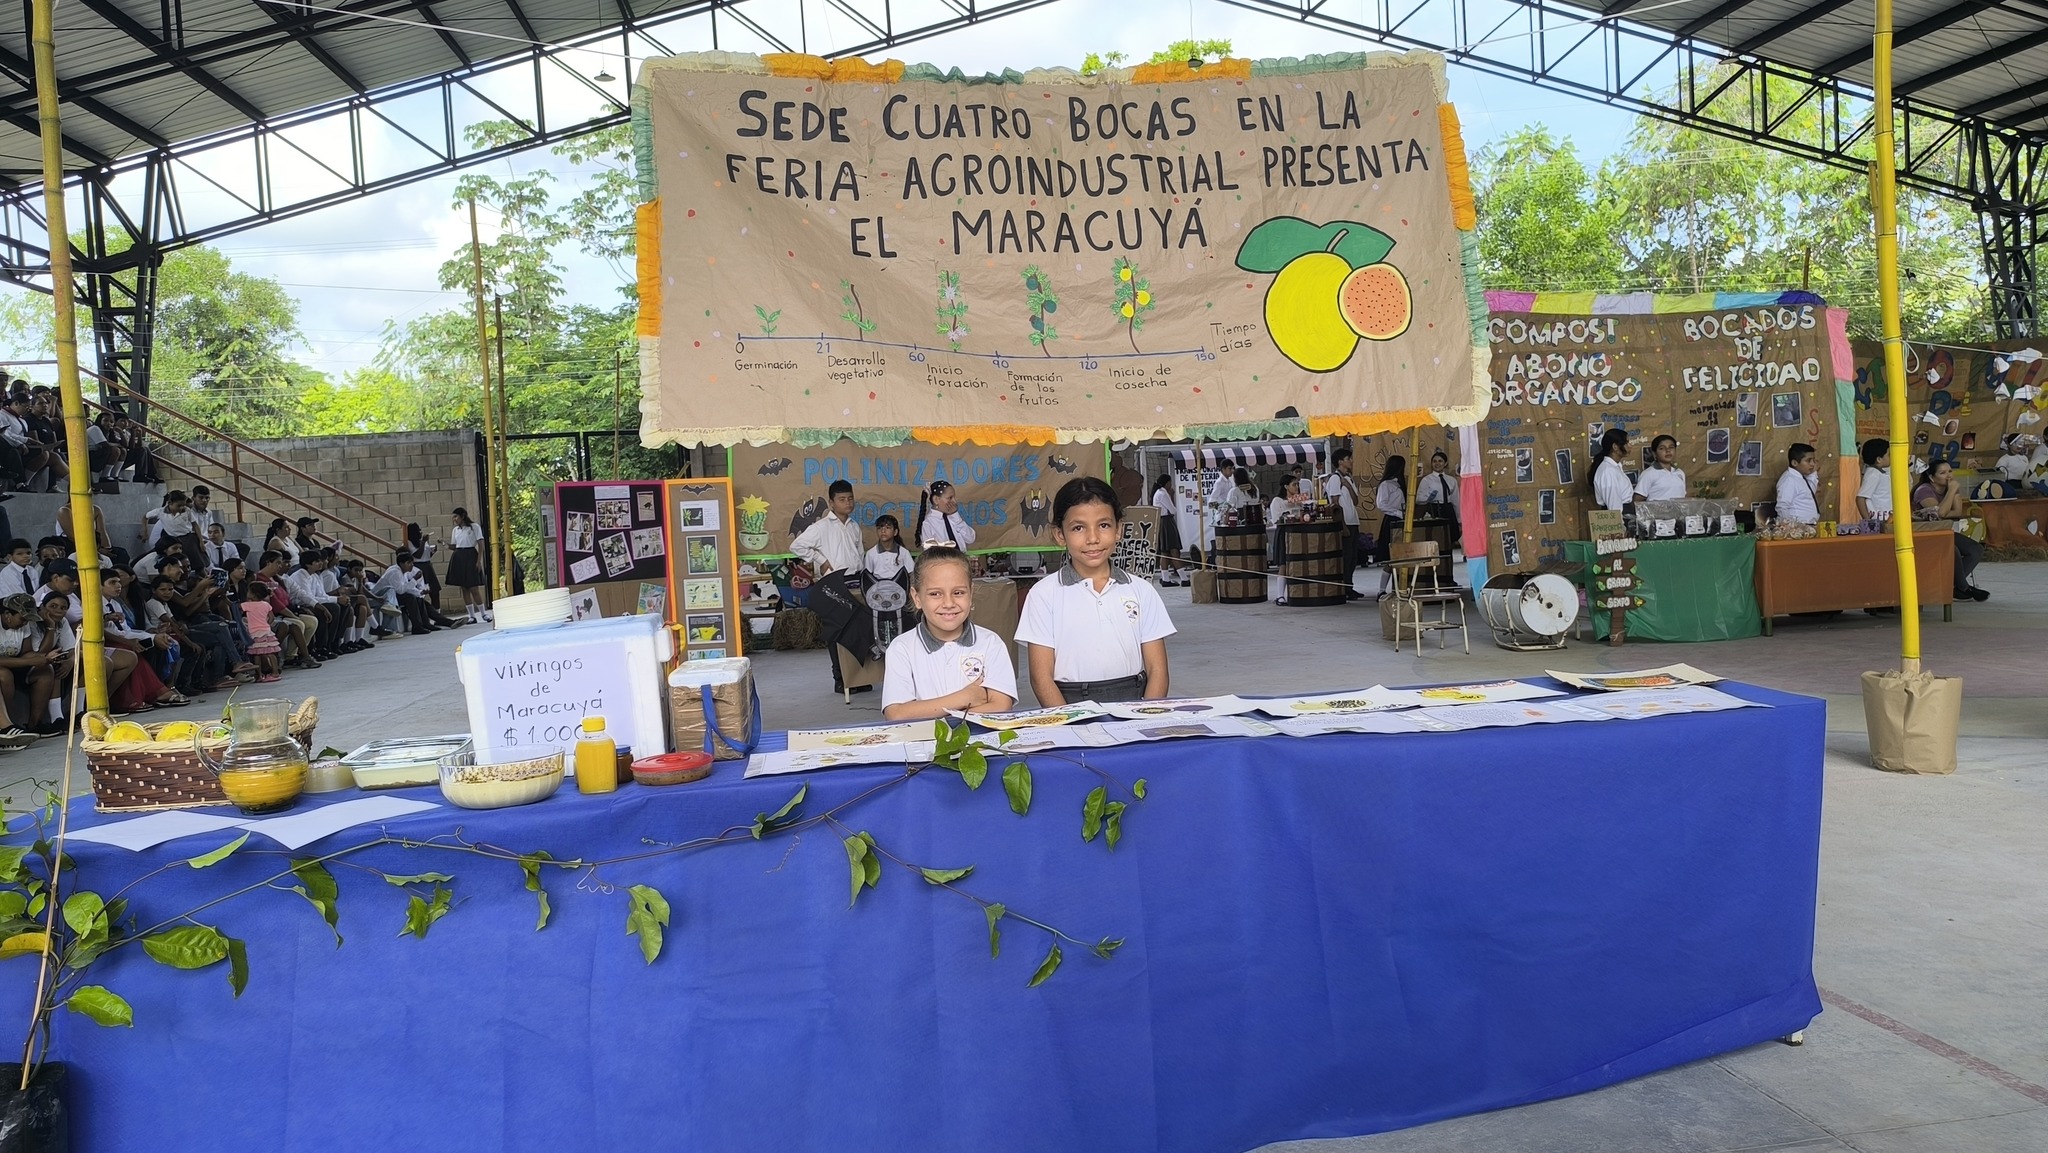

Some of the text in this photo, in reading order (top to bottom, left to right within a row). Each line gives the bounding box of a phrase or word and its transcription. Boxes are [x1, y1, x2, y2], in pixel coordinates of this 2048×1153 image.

[737, 89, 1361, 143] SEDE CUATRO BOCAS EN LA
[726, 138, 1429, 202] FERIA AGROINDUSTRIAL PRESENTA
[851, 198, 1207, 258] EL MARACUYÁ
[1210, 322, 1257, 339] Tiempo
[1683, 305, 1816, 342] BOCADOS
[735, 342, 745, 354] 0
[816, 342, 830, 354] 21
[1219, 338, 1252, 353] días
[1734, 337, 1763, 362] DE
[827, 351, 886, 368] Desarrollo
[908, 351, 926, 363] 60
[1195, 351, 1216, 362] 150
[734, 359, 798, 371] Germinación
[926, 363, 963, 376] Inicio
[992, 359, 1009, 370] 90
[1079, 360, 1098, 371] 120
[1108, 363, 1172, 378] Inicio de
[1505, 352, 1612, 381] ABONO
[827, 368, 884, 384] vegetativo
[926, 375, 989, 389] floración
[1007, 370, 1063, 384] Formación
[1115, 376, 1168, 390] cosecha
[1682, 358, 1820, 393] FELICIDAD
[1010, 381, 1055, 393] de los
[1490, 377, 1642, 408] ORGANICO
[1018, 393, 1059, 406] frutos
[1689, 400, 1736, 415] mermelada
[803, 454, 1041, 486] POLINIZADORES
[1613, 559, 1623, 571] AL
[530, 682, 551, 697] de
[498, 689, 602, 720] Maracuyá
